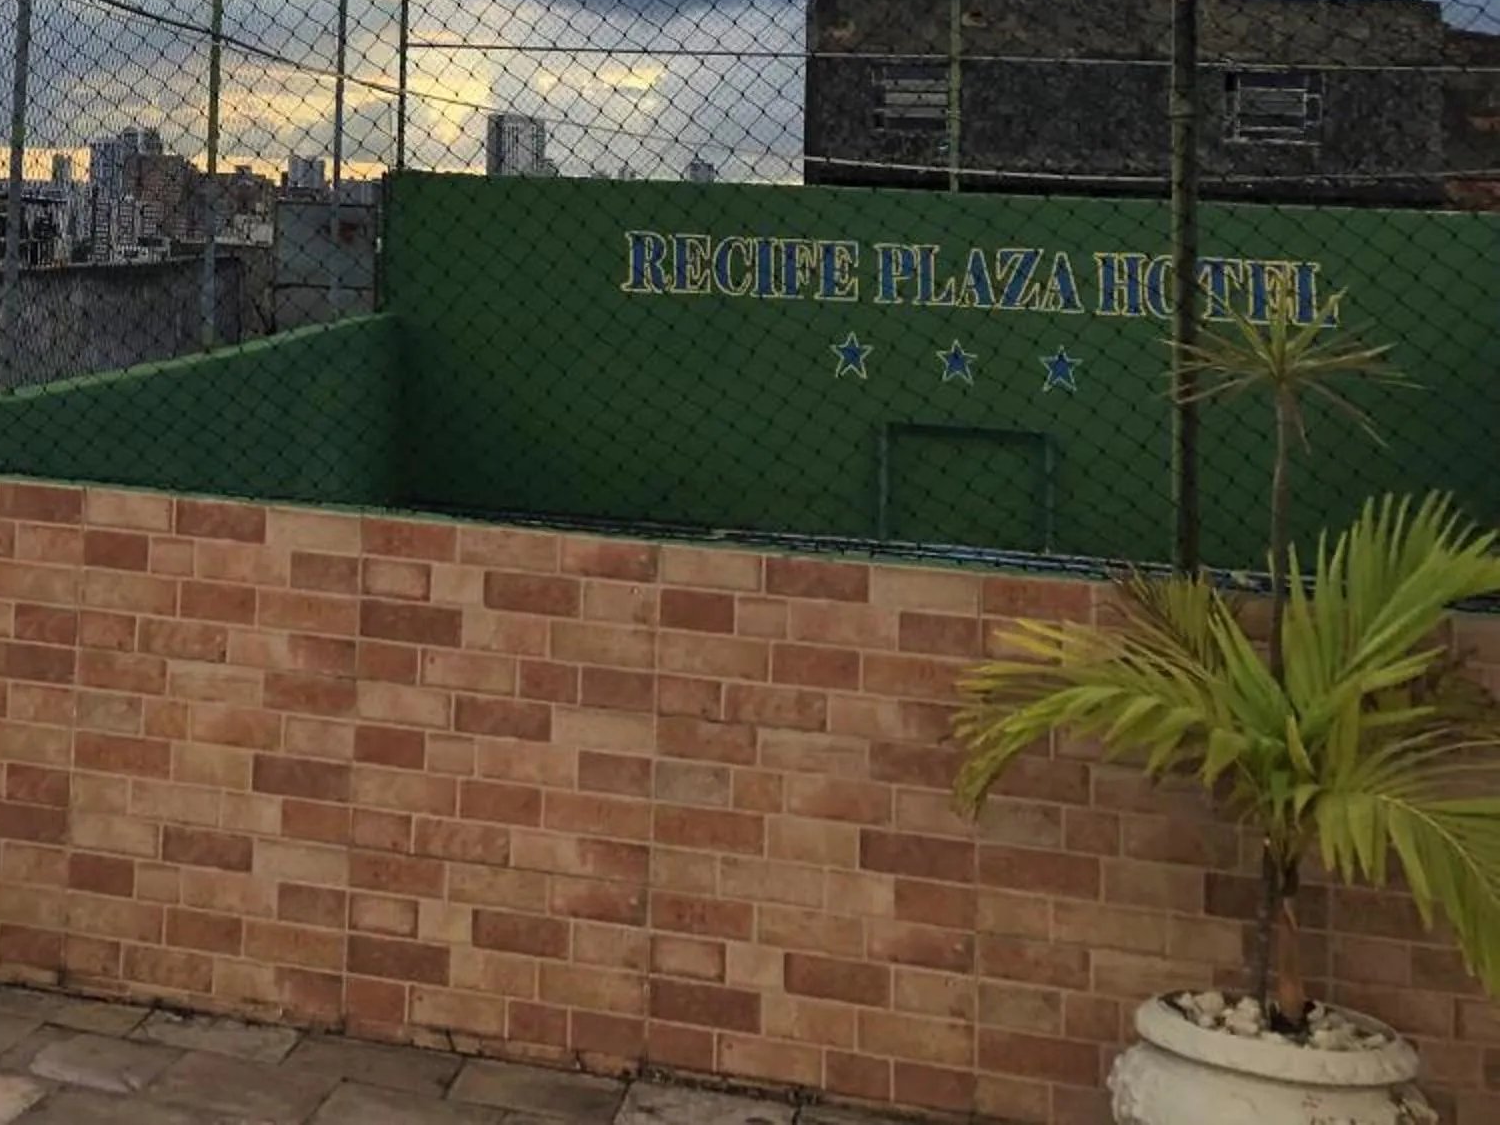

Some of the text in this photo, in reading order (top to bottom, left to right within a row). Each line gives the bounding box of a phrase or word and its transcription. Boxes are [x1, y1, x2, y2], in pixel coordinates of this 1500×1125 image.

[620, 231, 1340, 328] RECIFE PLAZA HOTEL
